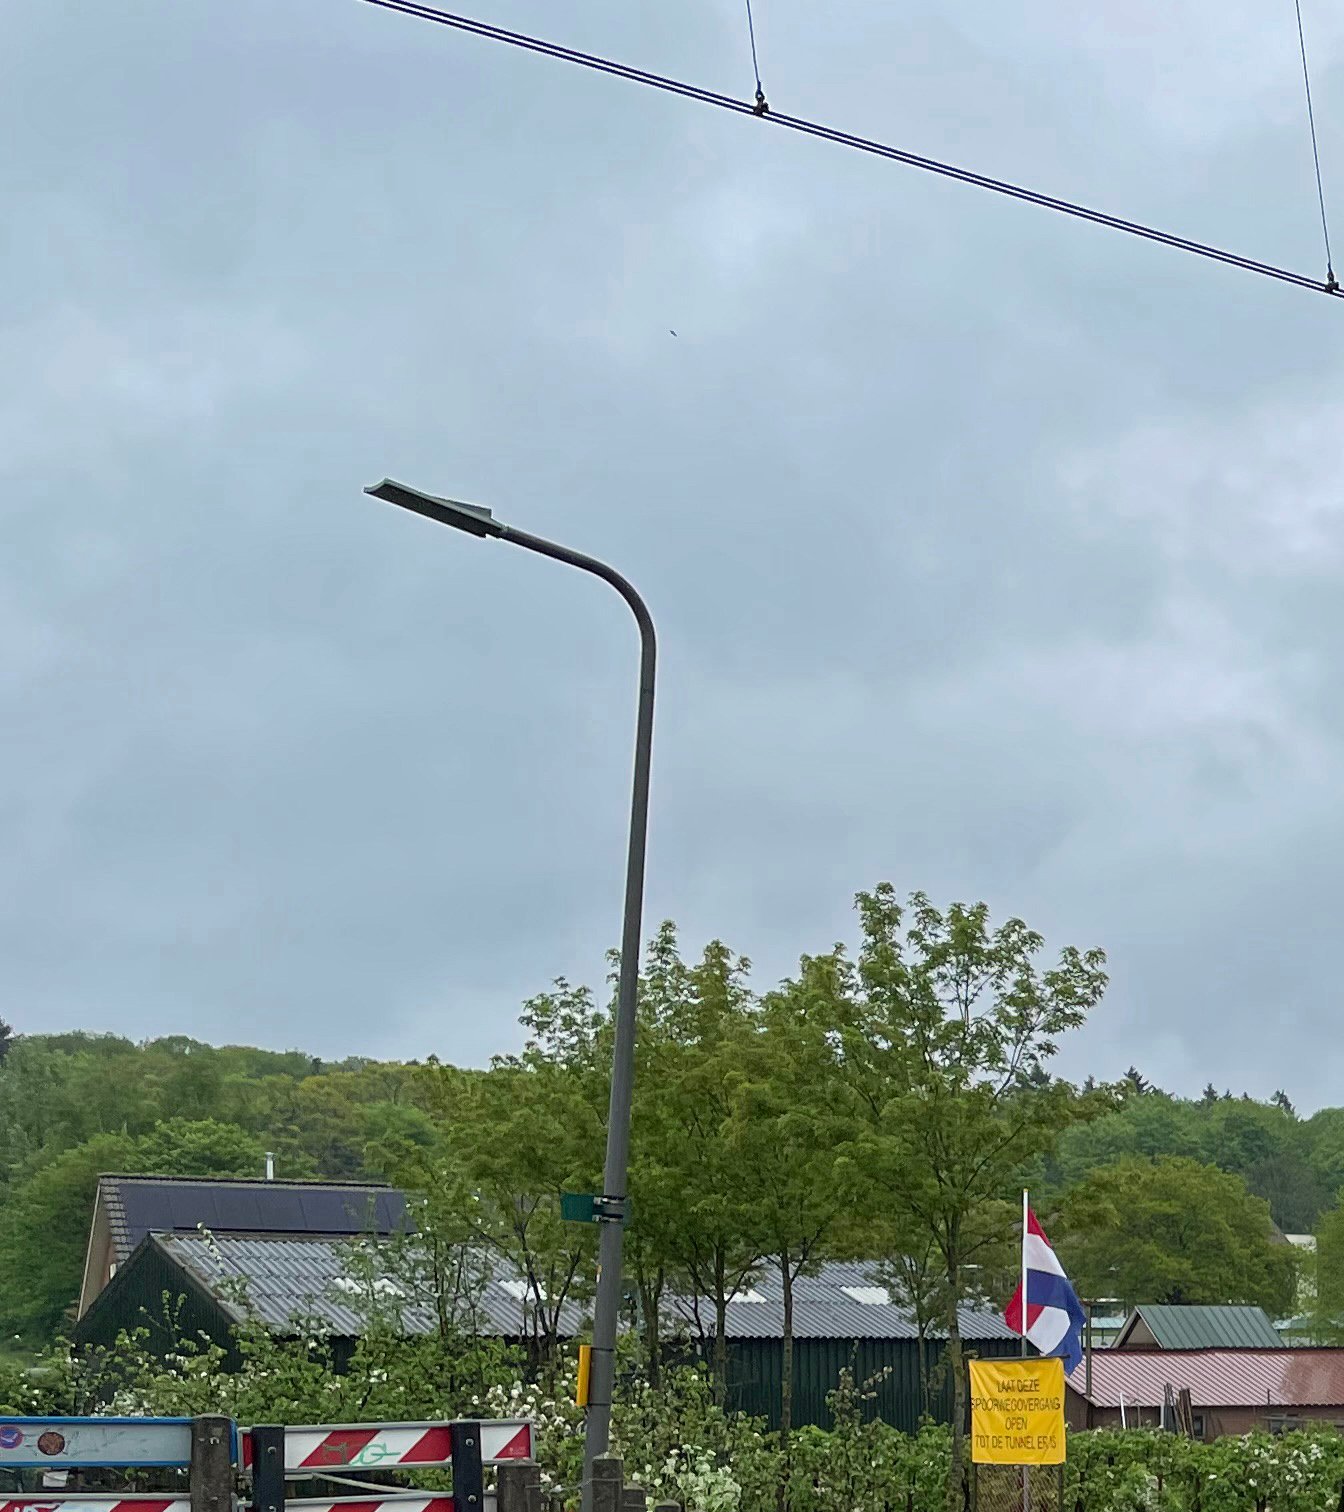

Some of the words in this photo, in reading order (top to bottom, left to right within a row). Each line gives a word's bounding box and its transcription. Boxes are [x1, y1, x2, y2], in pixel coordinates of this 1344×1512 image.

[997, 1379, 1015, 1393] LAAT
[1016, 1378, 1040, 1392] DEZE
[1005, 1416, 1028, 1430] OPEN
[975, 1434, 989, 1448] TOT
[991, 1435, 1003, 1449] DE
[1005, 1435, 1036, 1449] TUNNEL
